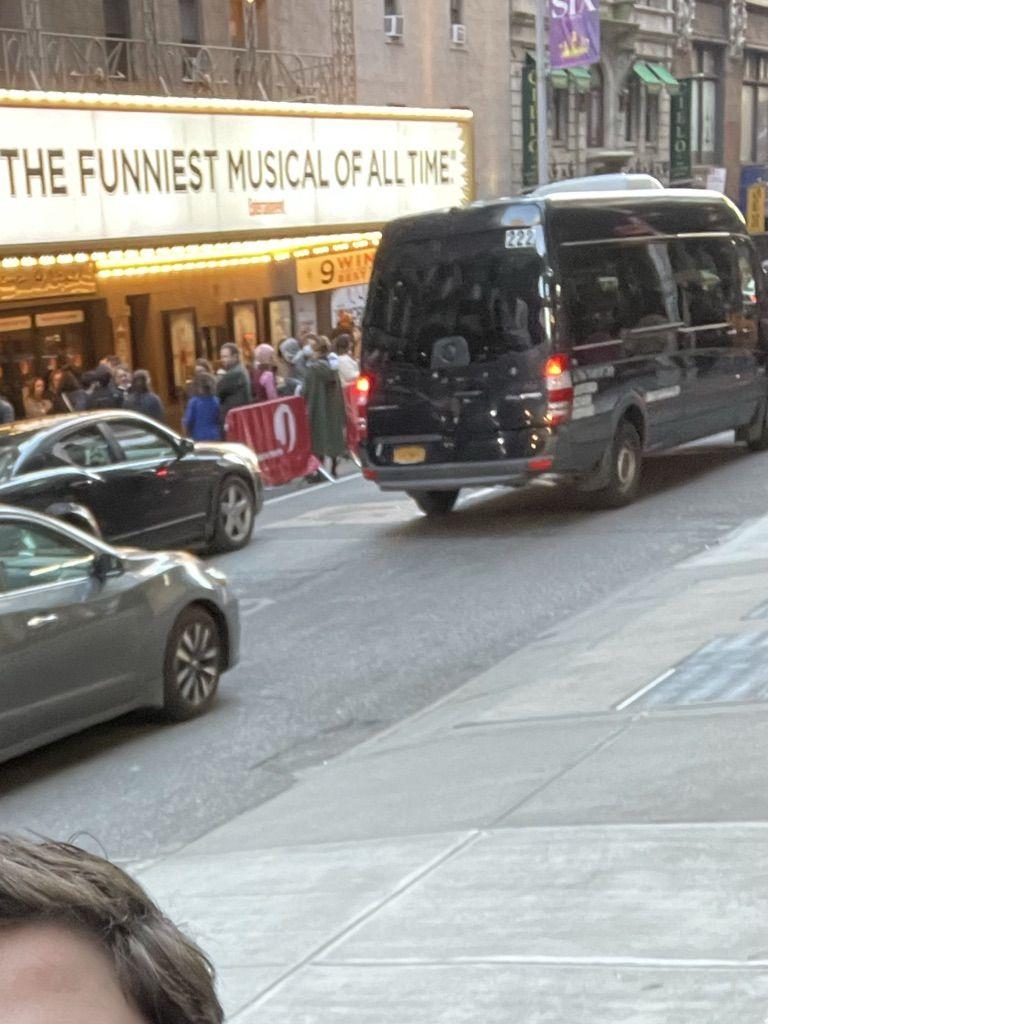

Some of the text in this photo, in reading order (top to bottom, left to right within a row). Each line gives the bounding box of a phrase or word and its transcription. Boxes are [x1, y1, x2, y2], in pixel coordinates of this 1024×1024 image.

[78, 148, 219, 195] FUNNIEST
[227, 149, 329, 192] MUSICAL
[334, 149, 362, 187] OF
[367, 149, 405, 187] ALL
[507, 229, 534, 247] 222
[320, 259, 335, 285] 9
